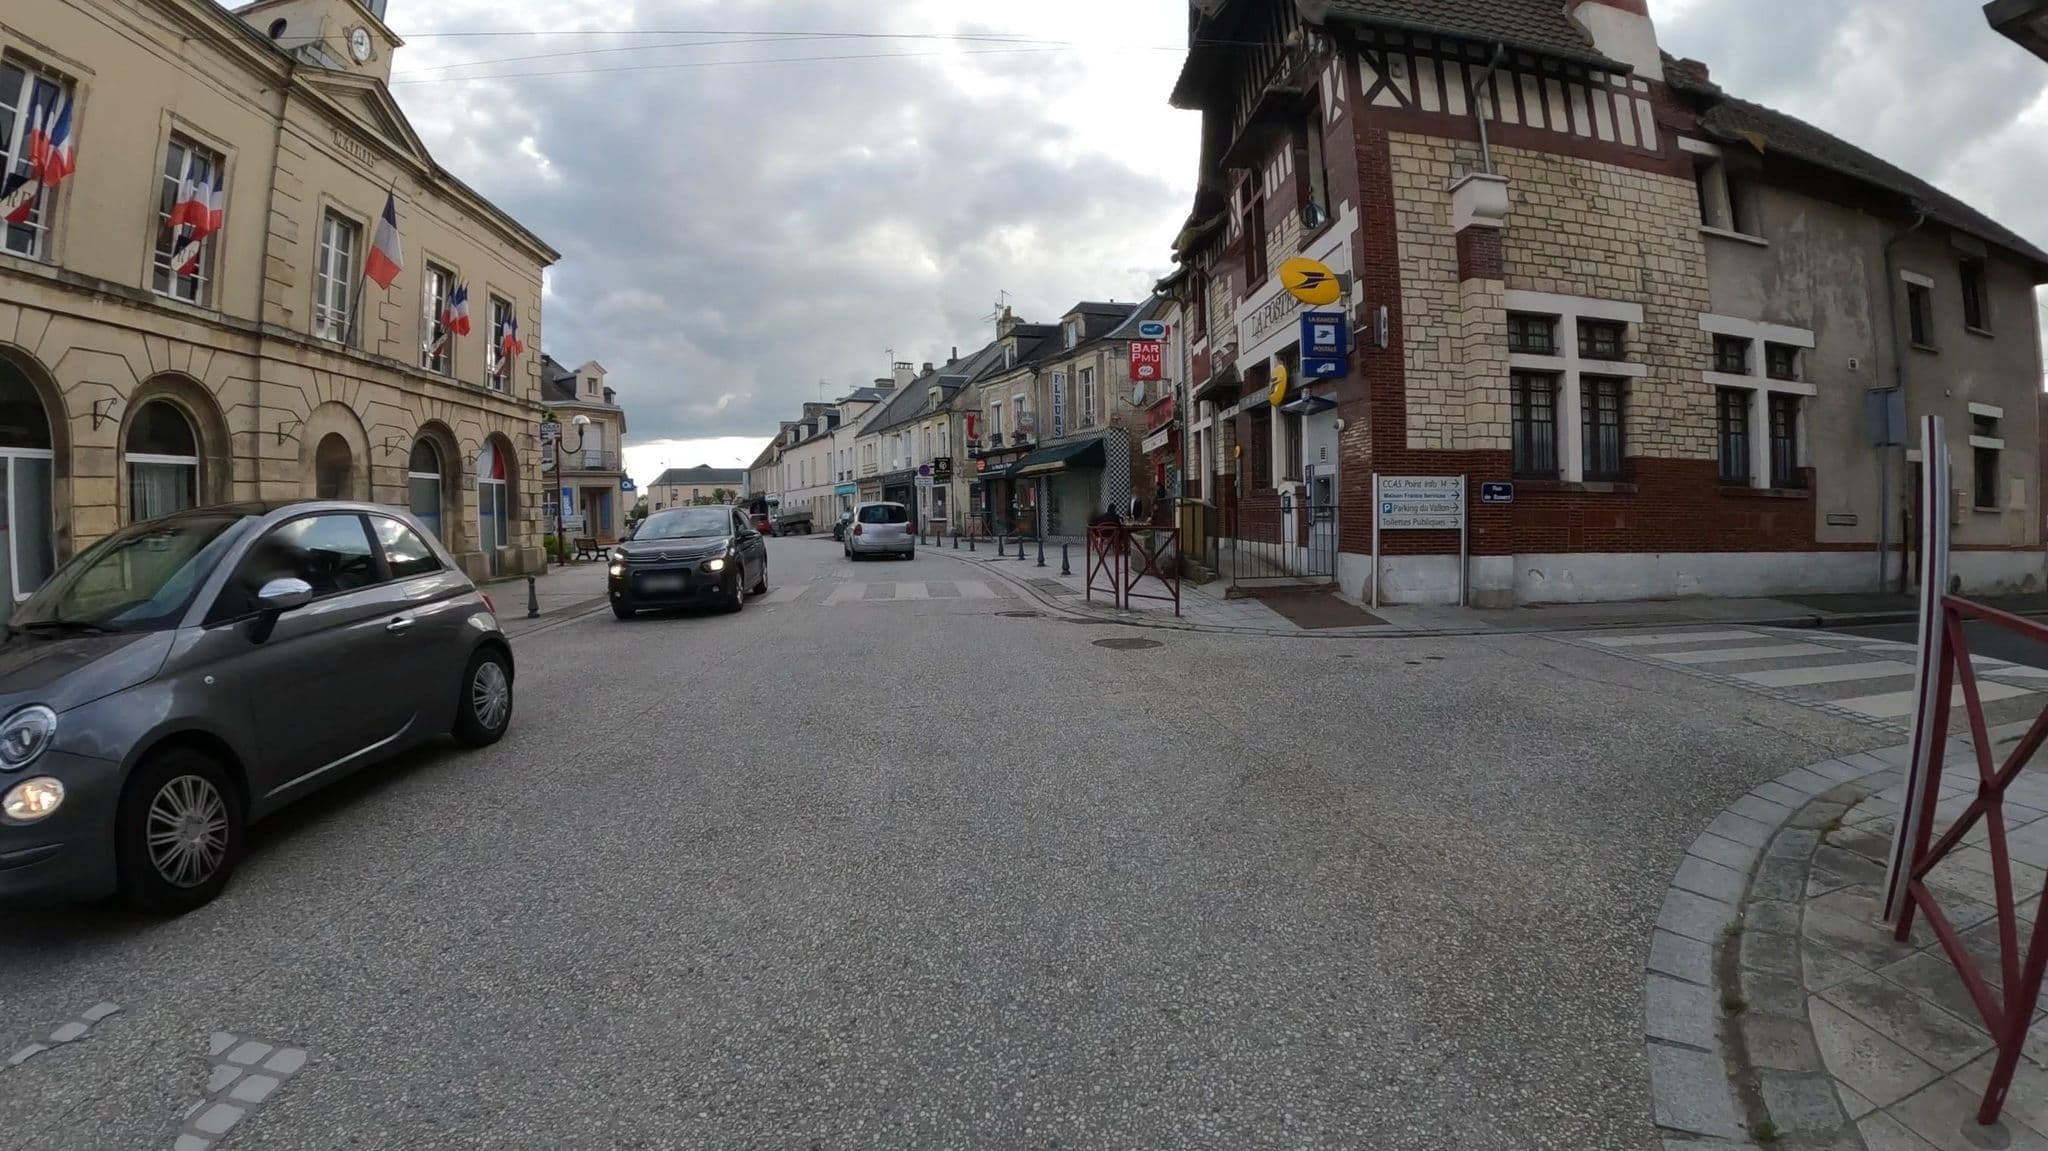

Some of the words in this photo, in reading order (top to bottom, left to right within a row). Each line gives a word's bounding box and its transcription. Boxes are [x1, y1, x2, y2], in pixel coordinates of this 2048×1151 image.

[333, 131, 375, 168] MAIRIE
[1250, 310, 1262, 338] LA
[1131, 343, 1159, 353] BAR
[1131, 353, 1159, 362] PMU
[1054, 374, 1062, 437] FLEURS
[1382, 480, 1402, 488] CCAS
[1405, 479, 1422, 488] Point
[1394, 503, 1418, 513] Parking
[1420, 503, 1428, 512] du
[1382, 518, 1411, 526] Toilettes
[1413, 518, 1446, 527] Publiques
